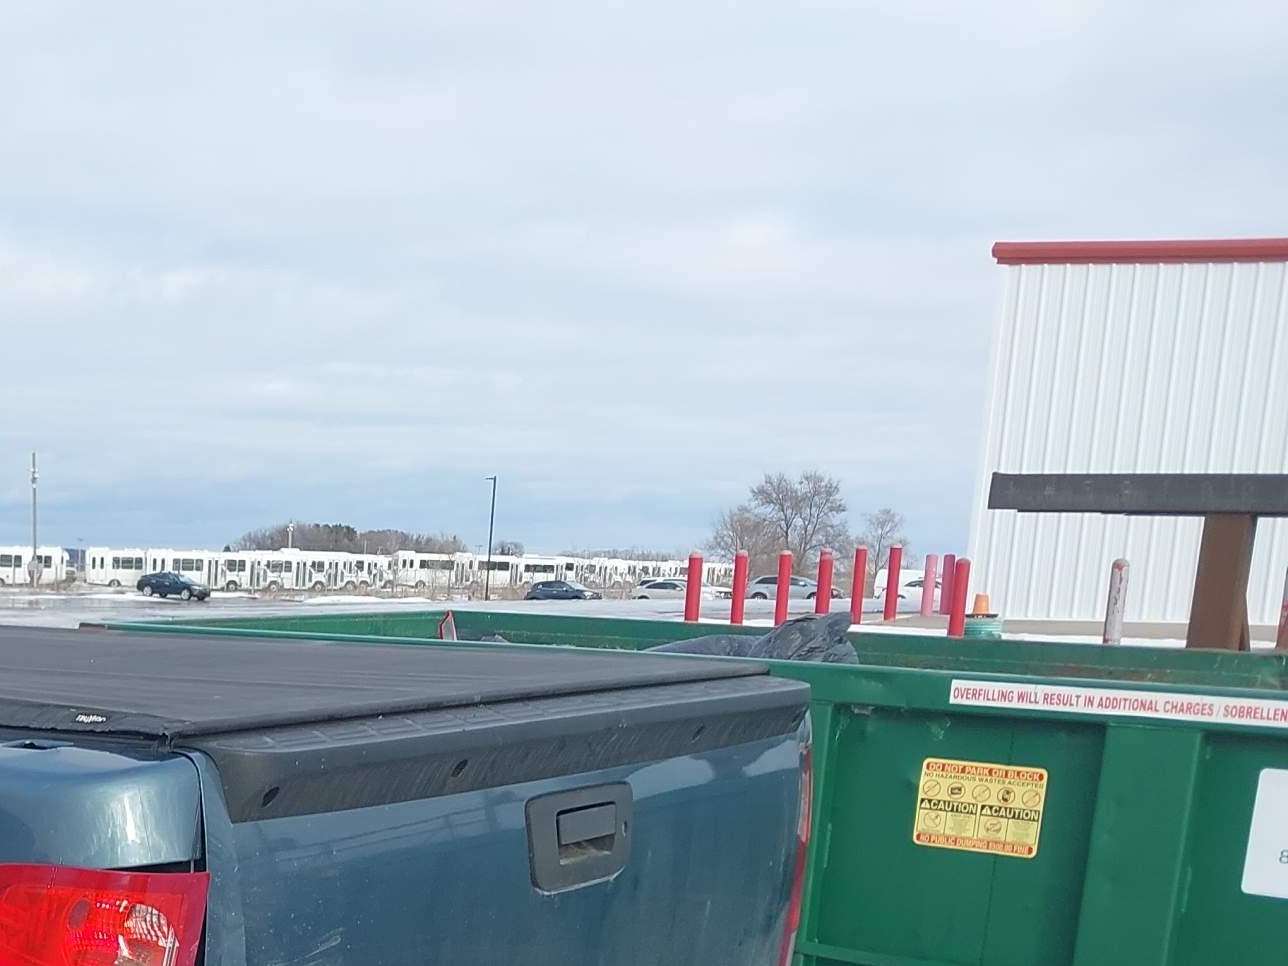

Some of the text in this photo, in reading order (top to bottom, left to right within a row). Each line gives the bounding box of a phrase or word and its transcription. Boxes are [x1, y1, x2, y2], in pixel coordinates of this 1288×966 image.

[953, 687, 1014, 703] OVERFILLING
[1017, 691, 1040, 705] WILL
[1043, 693, 1081, 708] RESULT
[1084, 695, 1095, 708] IN
[1097, 695, 1160, 712] ADDITIONAL
[1163, 701, 1214, 717] CHARGES
[929, 762, 1040, 780] DO NOT PARK OR BLOCK
[931, 801, 977, 814] CAUTION
[992, 807, 1039, 820] CAUTION
